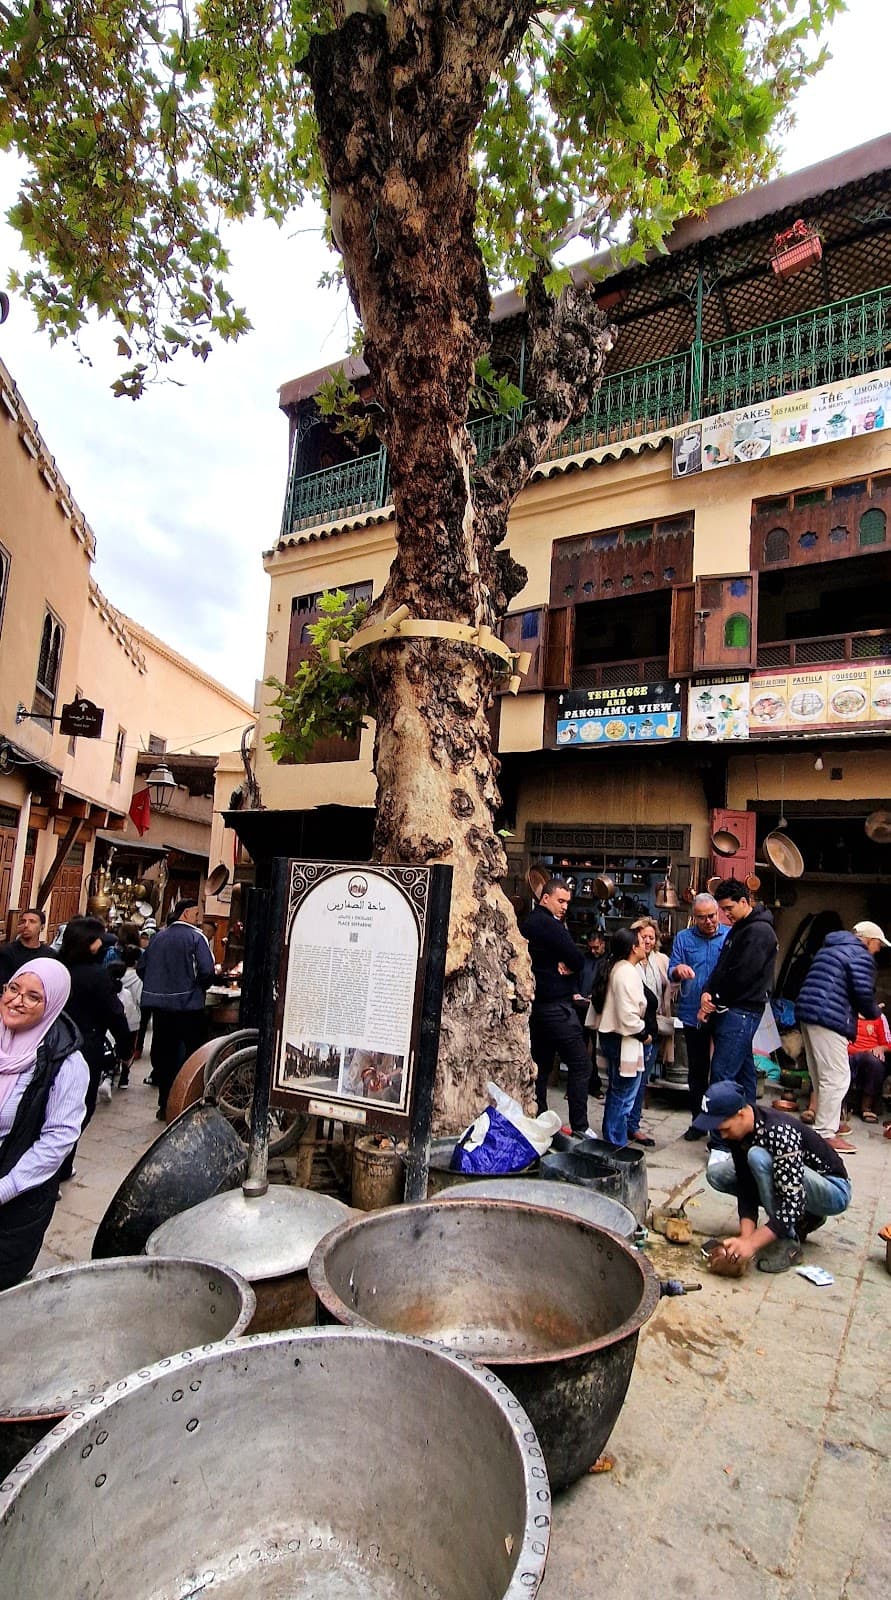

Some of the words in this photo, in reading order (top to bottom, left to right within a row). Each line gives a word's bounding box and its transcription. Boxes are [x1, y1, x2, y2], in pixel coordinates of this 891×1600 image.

[854, 380, 891, 395] LIMONAD
[736, 408, 771, 421] CAKES
[792, 675, 823, 684] PASTILLA
[831, 671, 867, 681] COUSCOUS
[587, 686, 649, 701] TERRASSE
[606, 698, 627, 707] AND
[564, 704, 634, 720] PANORAMIC
[638, 702, 673, 715] VIEW
[326, 899, 365, 912] الصفارين
[367, 901, 386, 911] ساحة
